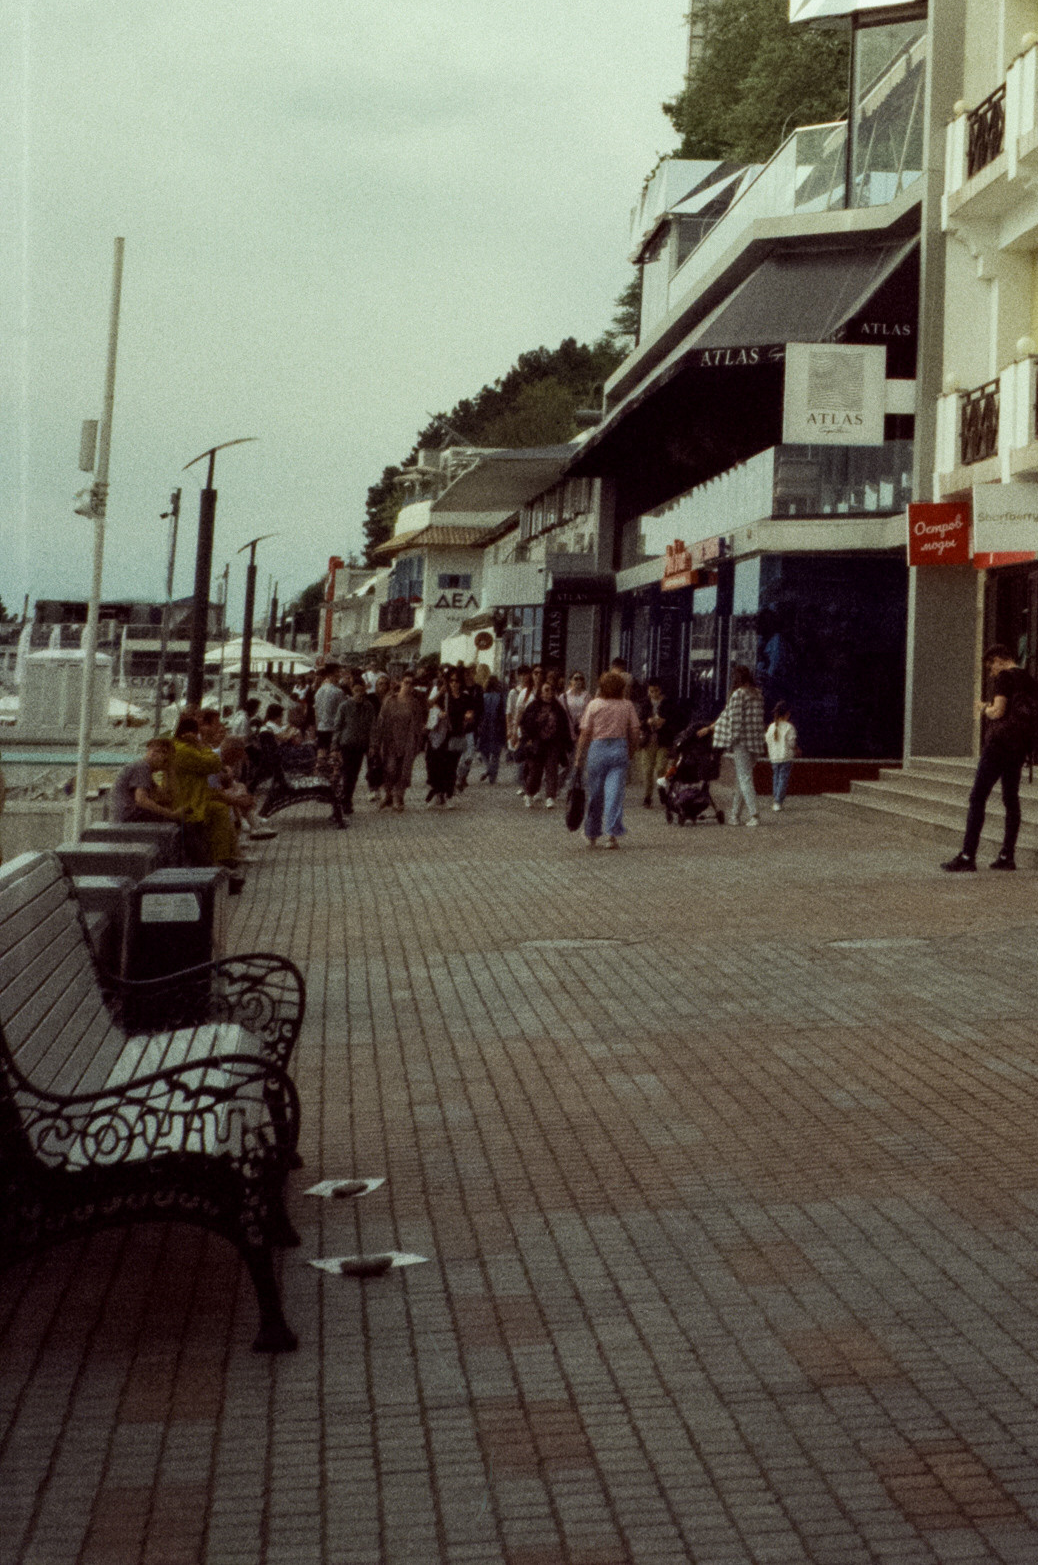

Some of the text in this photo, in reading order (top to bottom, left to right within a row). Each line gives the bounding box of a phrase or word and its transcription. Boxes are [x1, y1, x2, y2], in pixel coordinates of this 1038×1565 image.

[861, 323, 911, 335] ATLAS
[701, 348, 759, 367] ATLAS
[806, 413, 864, 426] ATLAS
[914, 516, 964, 536] Остров
[920, 538, 957, 553] моды
